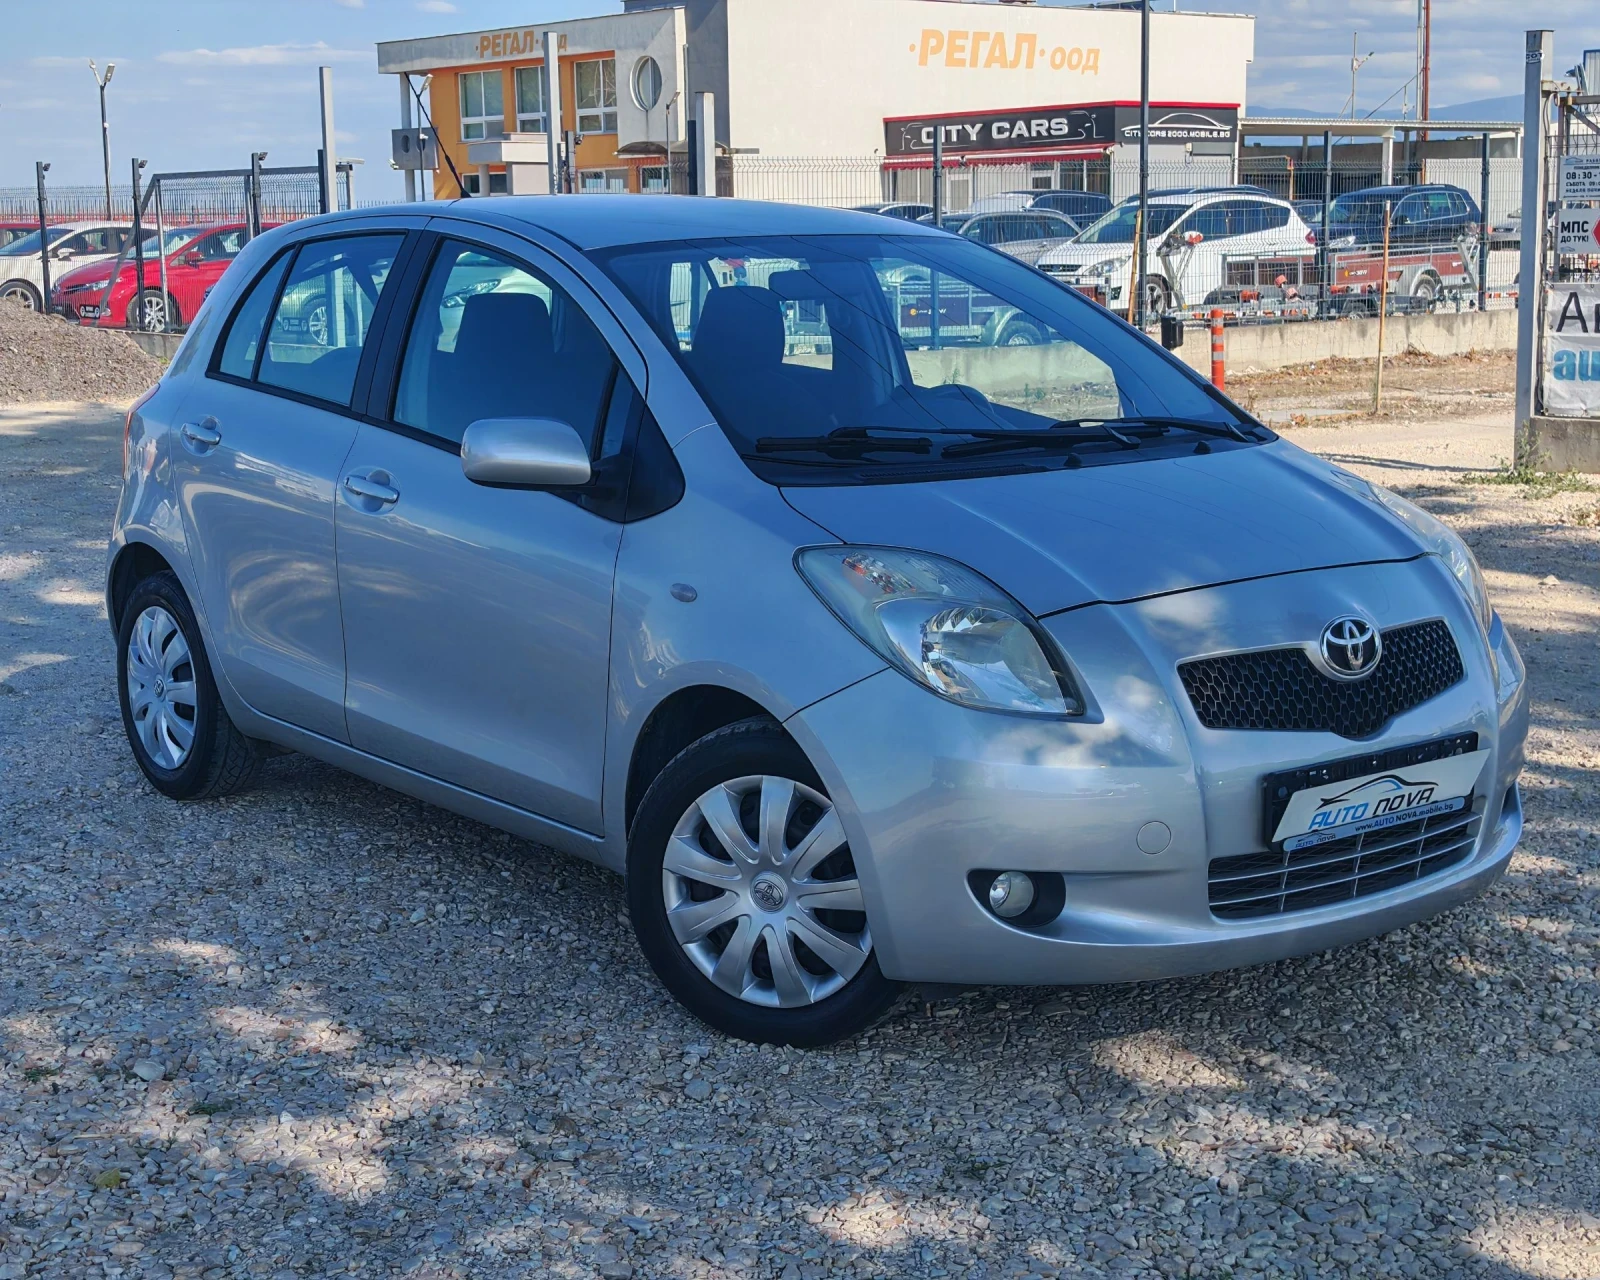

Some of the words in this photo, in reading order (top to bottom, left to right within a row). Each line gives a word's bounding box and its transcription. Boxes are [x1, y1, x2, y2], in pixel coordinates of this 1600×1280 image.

[480, 30, 534, 58] РЕГАЛ
[919, 29, 1037, 69] РЕГАЛ
[922, 123, 983, 144] CITY
[991, 118, 1069, 140] CARS
[1561, 221, 1589, 233] МПС
[1561, 235, 1571, 243] ДО
[1308, 802, 1369, 830] AUTO
[1372, 787, 1435, 816] NOVA
